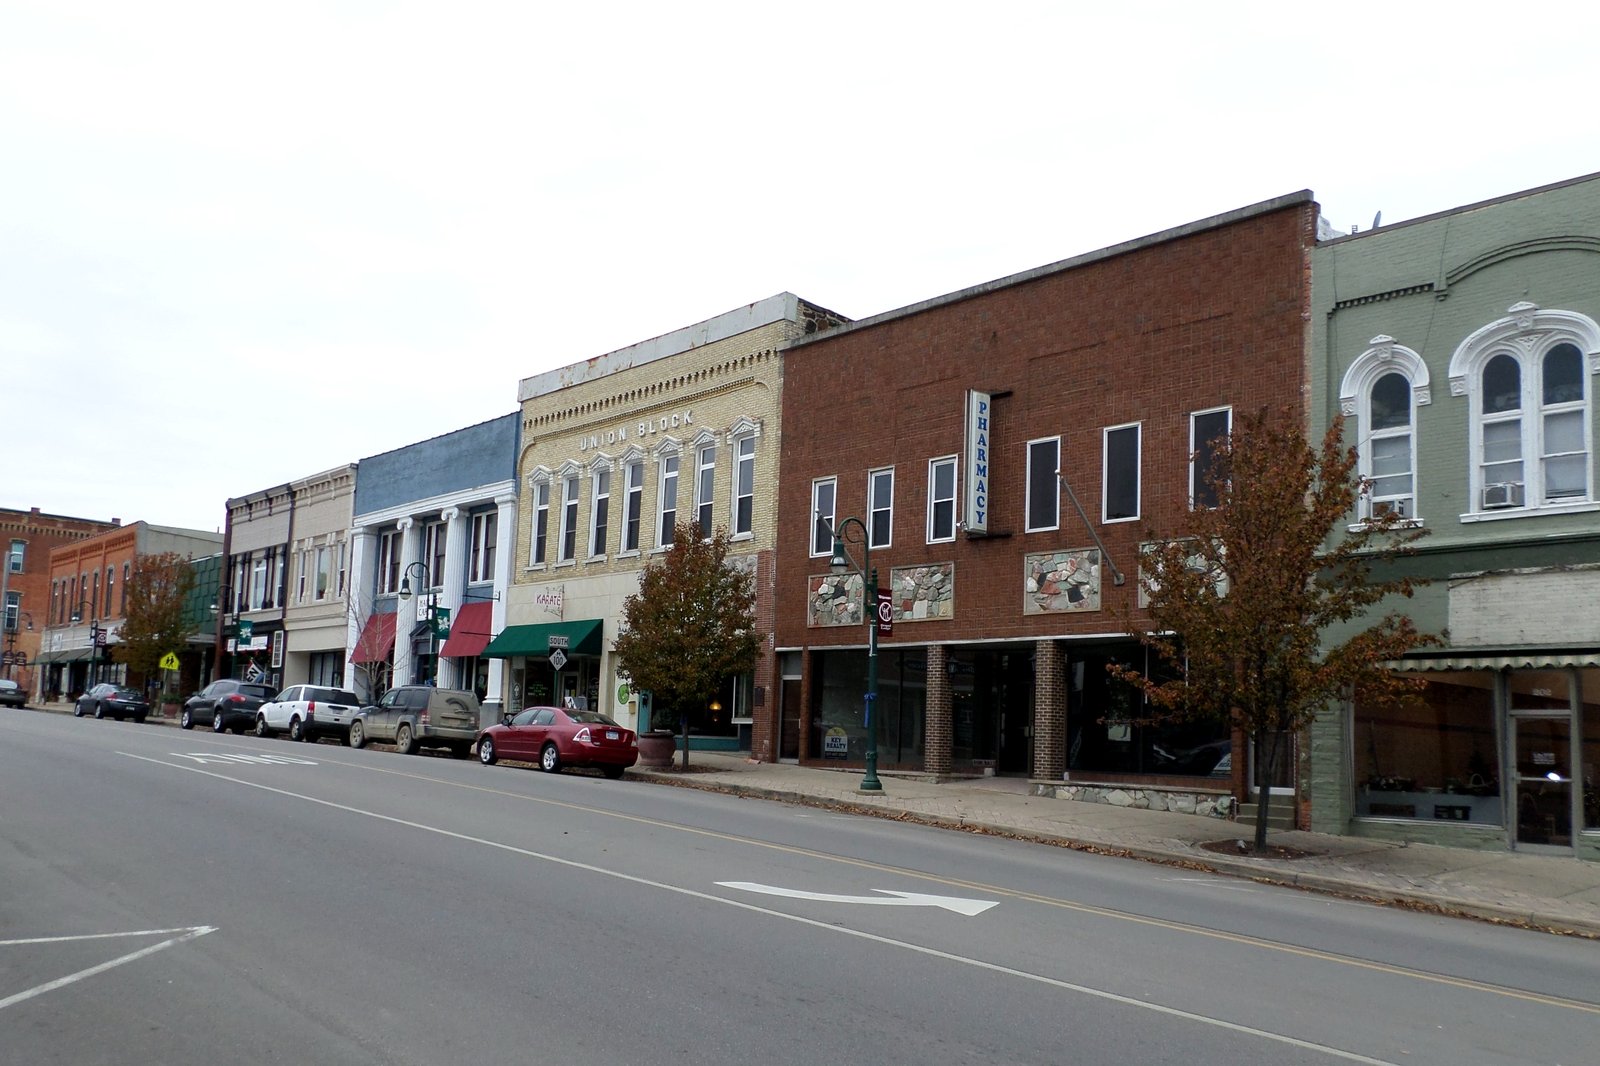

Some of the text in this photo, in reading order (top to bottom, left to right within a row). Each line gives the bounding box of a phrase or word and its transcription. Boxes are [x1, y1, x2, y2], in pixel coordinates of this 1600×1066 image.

[580, 410, 694, 451] UNION BLOCK
[975, 401, 988, 524] PHARMACY
[536, 594, 561, 606] KARATE
[550, 637, 569, 645] SOUTH
[553, 656, 564, 666] 100
